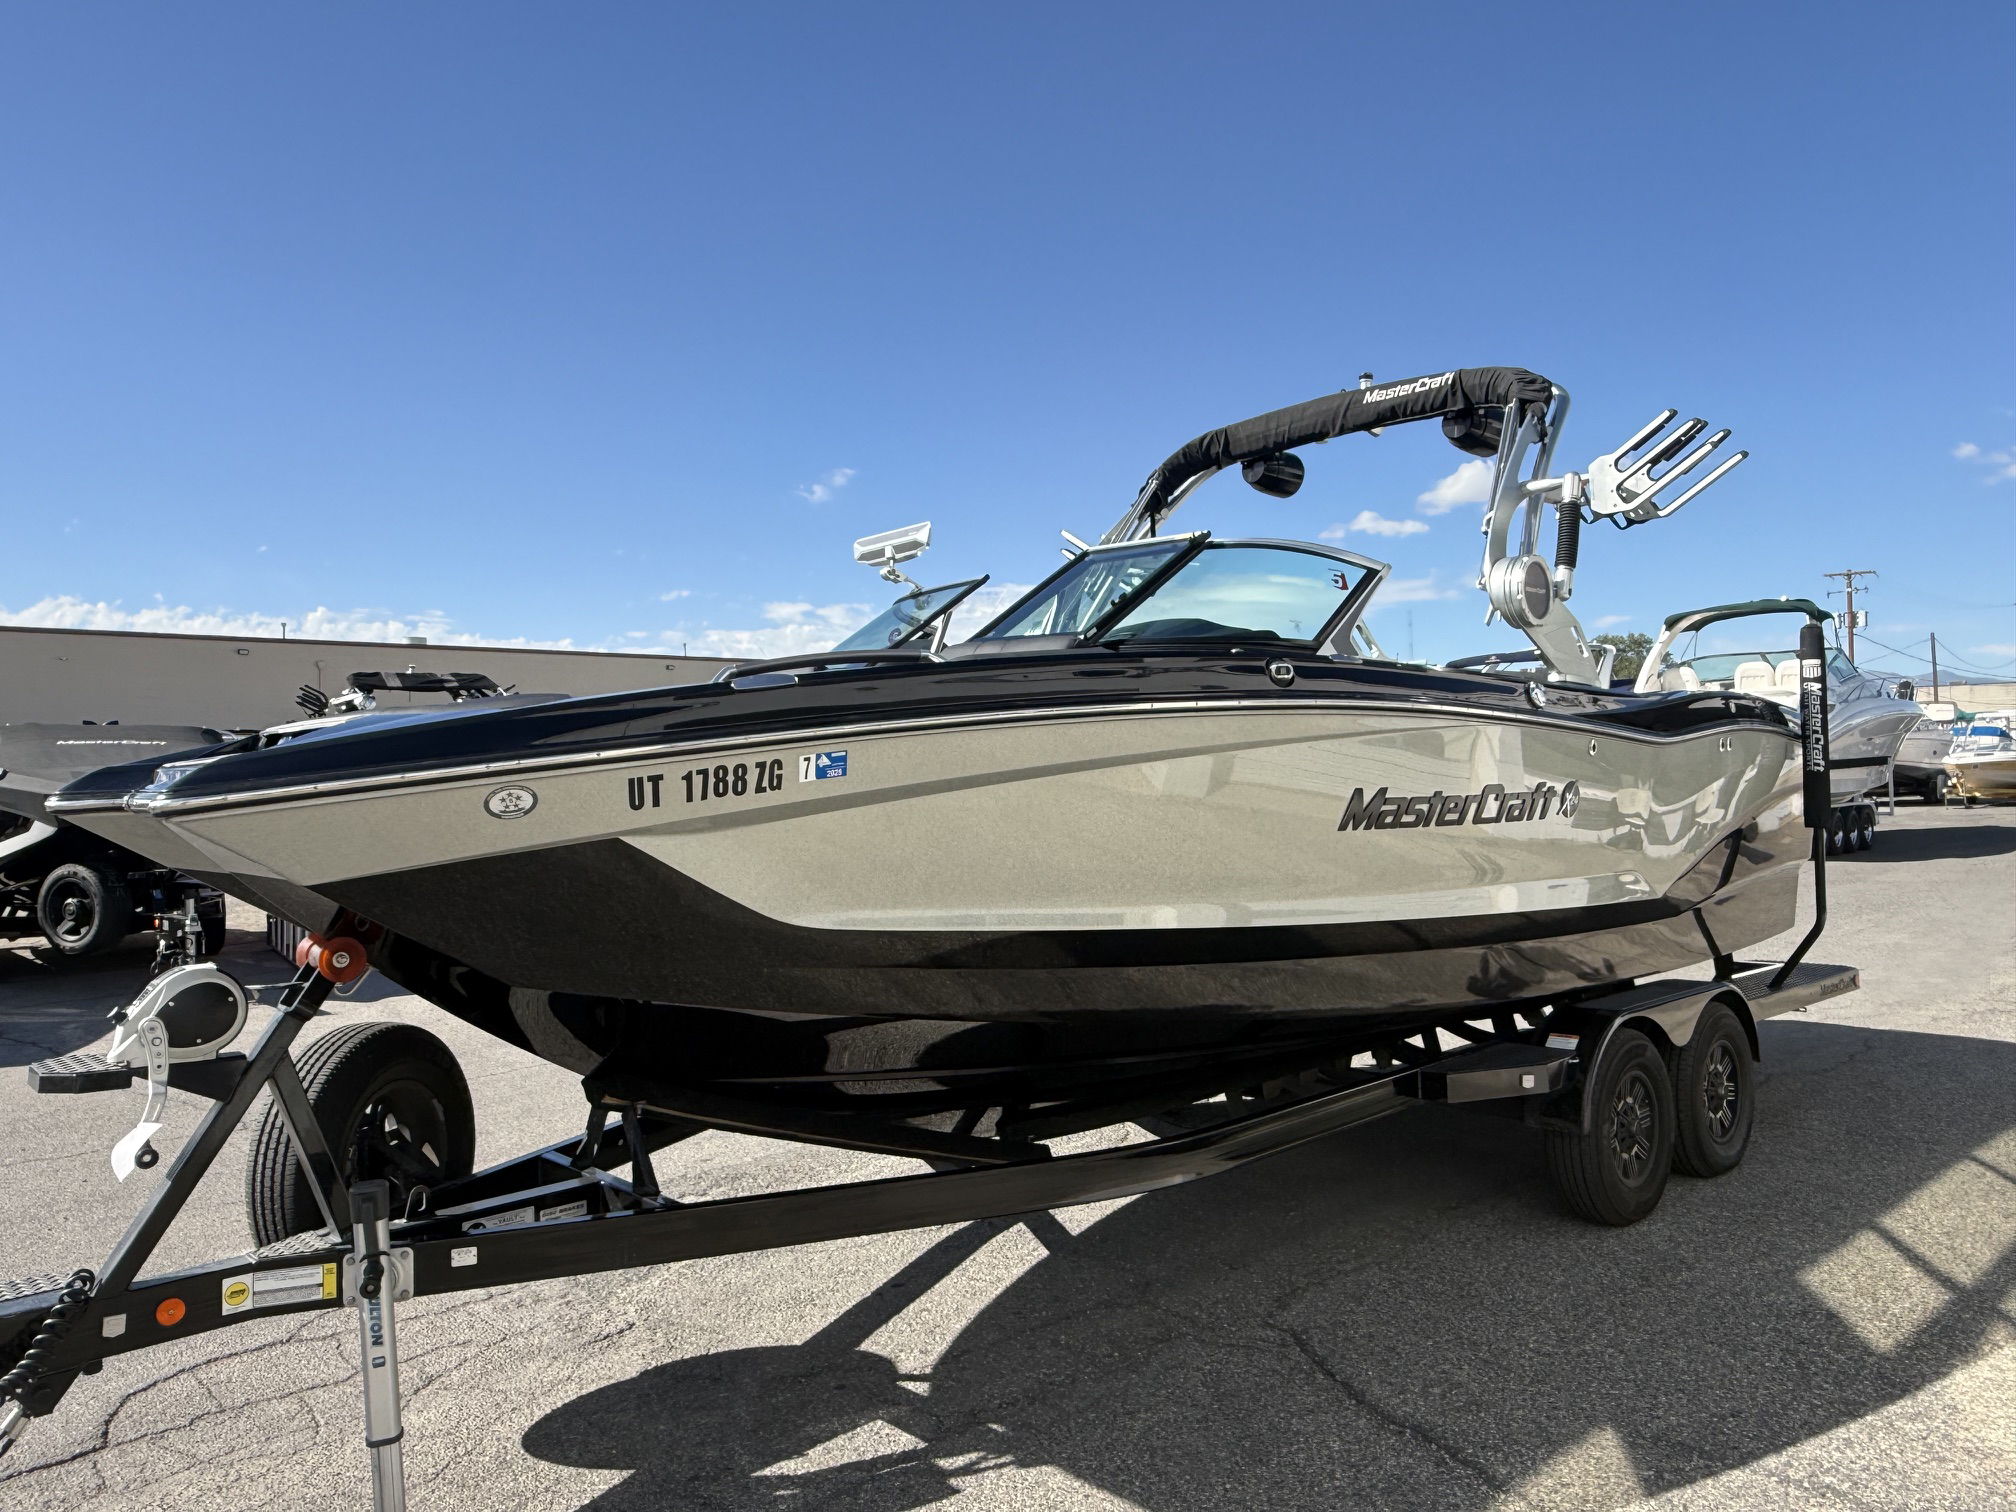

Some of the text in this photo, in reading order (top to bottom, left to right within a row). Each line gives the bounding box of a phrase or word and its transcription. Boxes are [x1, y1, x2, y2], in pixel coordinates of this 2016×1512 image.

[1363, 371, 1455, 404] MasterCraft
[1810, 682, 1825, 772] MasterCraft
[628, 759, 784, 811] UT 1788 ZG
[803, 756, 811, 780] 7
[1337, 781, 1557, 832] MasterCraft
[368, 1296, 384, 1346] ULTON
